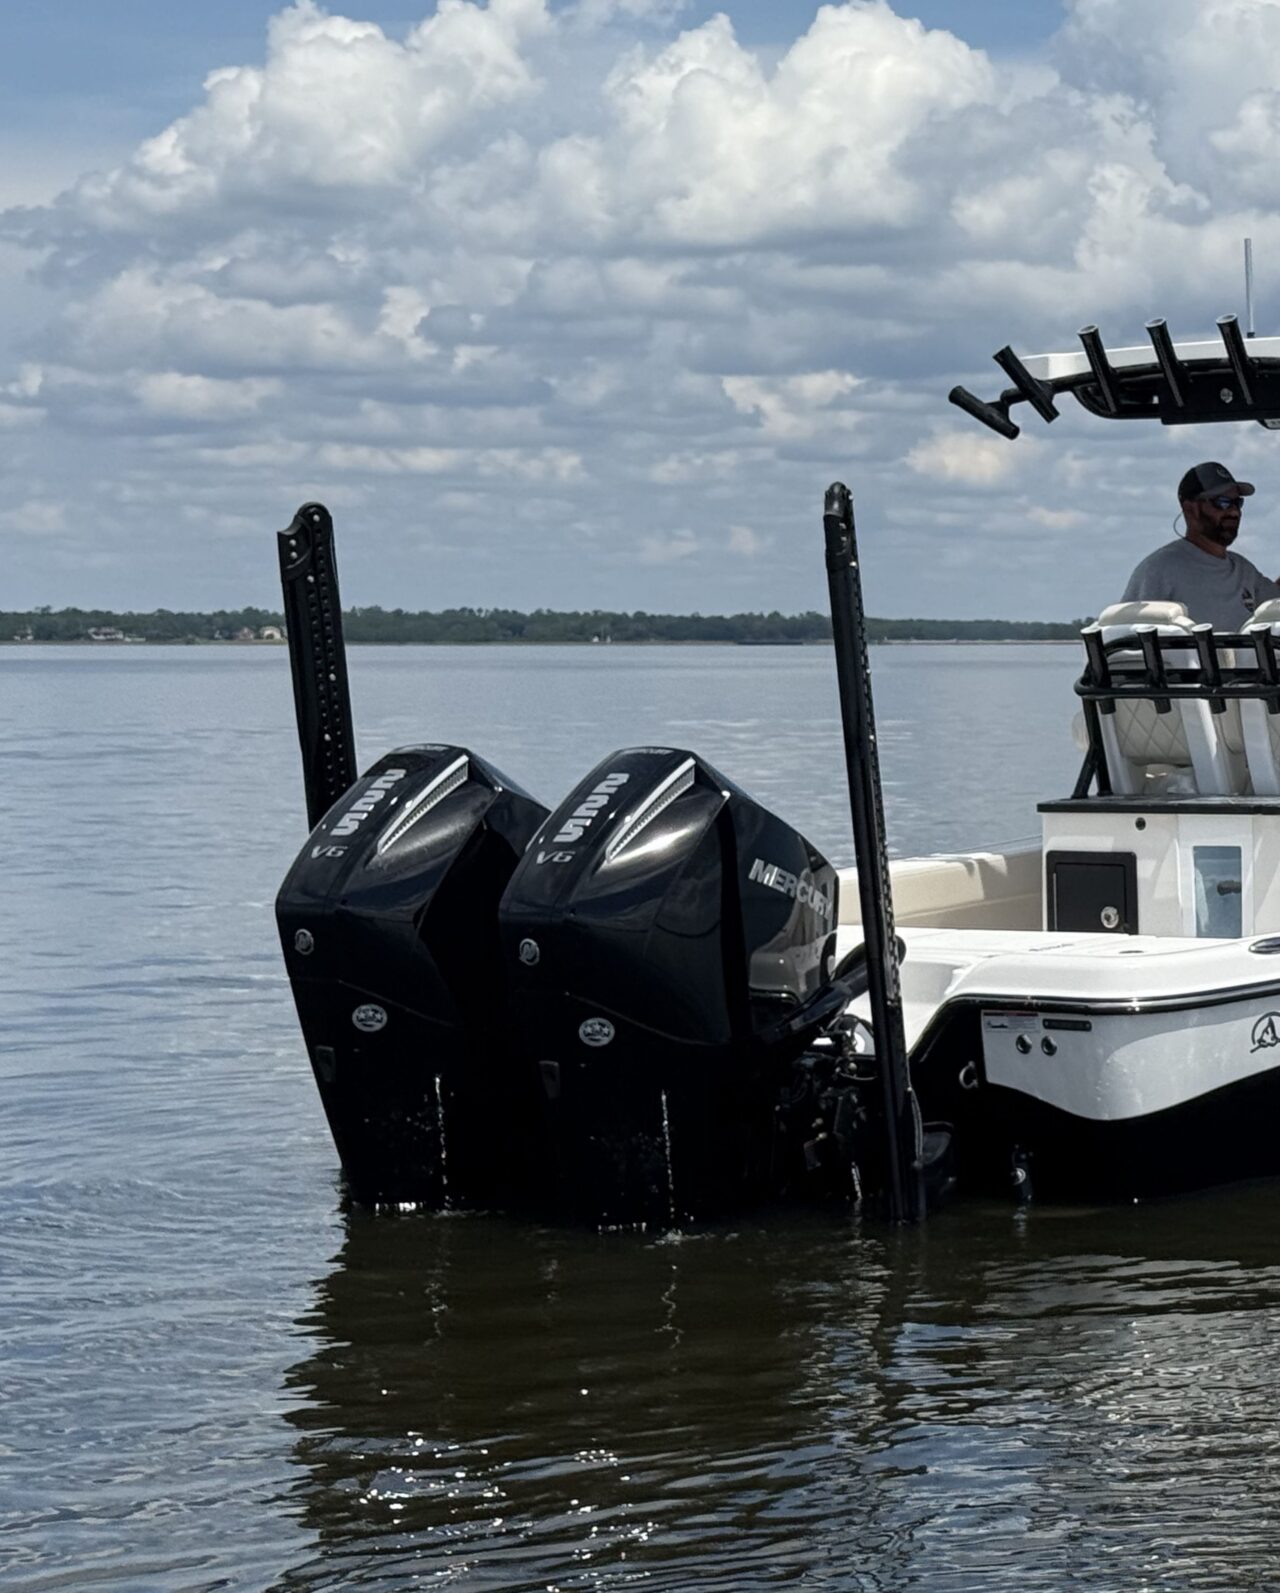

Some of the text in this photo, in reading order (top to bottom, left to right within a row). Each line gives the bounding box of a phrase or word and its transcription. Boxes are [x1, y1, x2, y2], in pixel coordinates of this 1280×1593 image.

[330, 768, 407, 836] 225
[552, 772, 630, 843] 225
[311, 844, 349, 859] V6
[536, 850, 577, 865] V6
[748, 858, 833, 920] MERCURY
